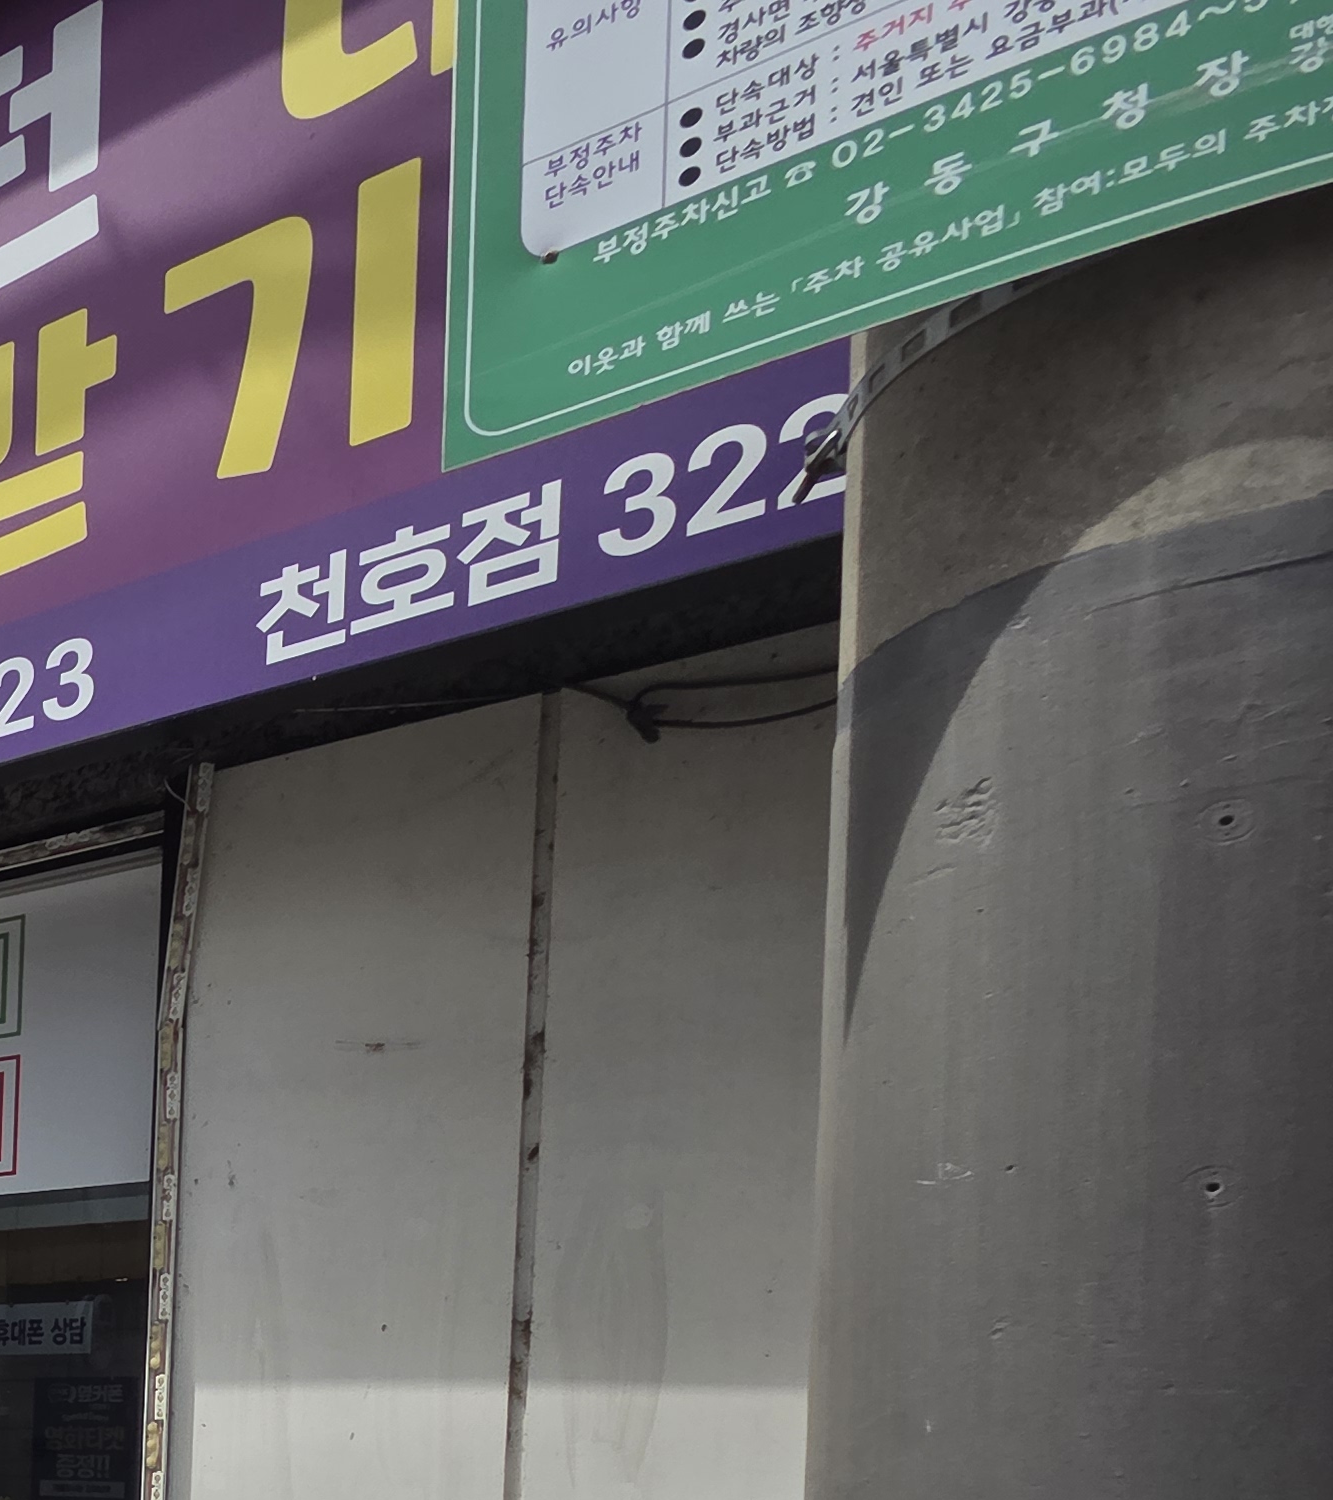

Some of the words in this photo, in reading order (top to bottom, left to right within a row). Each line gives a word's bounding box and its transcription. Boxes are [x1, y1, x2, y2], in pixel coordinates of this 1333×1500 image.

[713, 85, 817, 143] 부과근거
[851, 11, 989, 84] 서울특별시
[715, 53, 820, 115] 단속대상
[853, 3, 934, 52] 주거지
[716, 24, 786, 68] 차량의
[544, 122, 643, 177] 부정주차
[715, 112, 817, 174] 단속방법
[852, 76, 903, 118] 견인
[915, 54, 974, 88] 또는
[544, 150, 641, 209] 단속안내
[593, 174, 772, 264] 부정주차신고
[567, 337, 647, 377] 이웃과
[655, 311, 711, 350] 함께
[722, 290, 781, 325] 쓰는
[254, 477, 563, 667] 천호점
[50, 1316, 87, 1346] 상담
